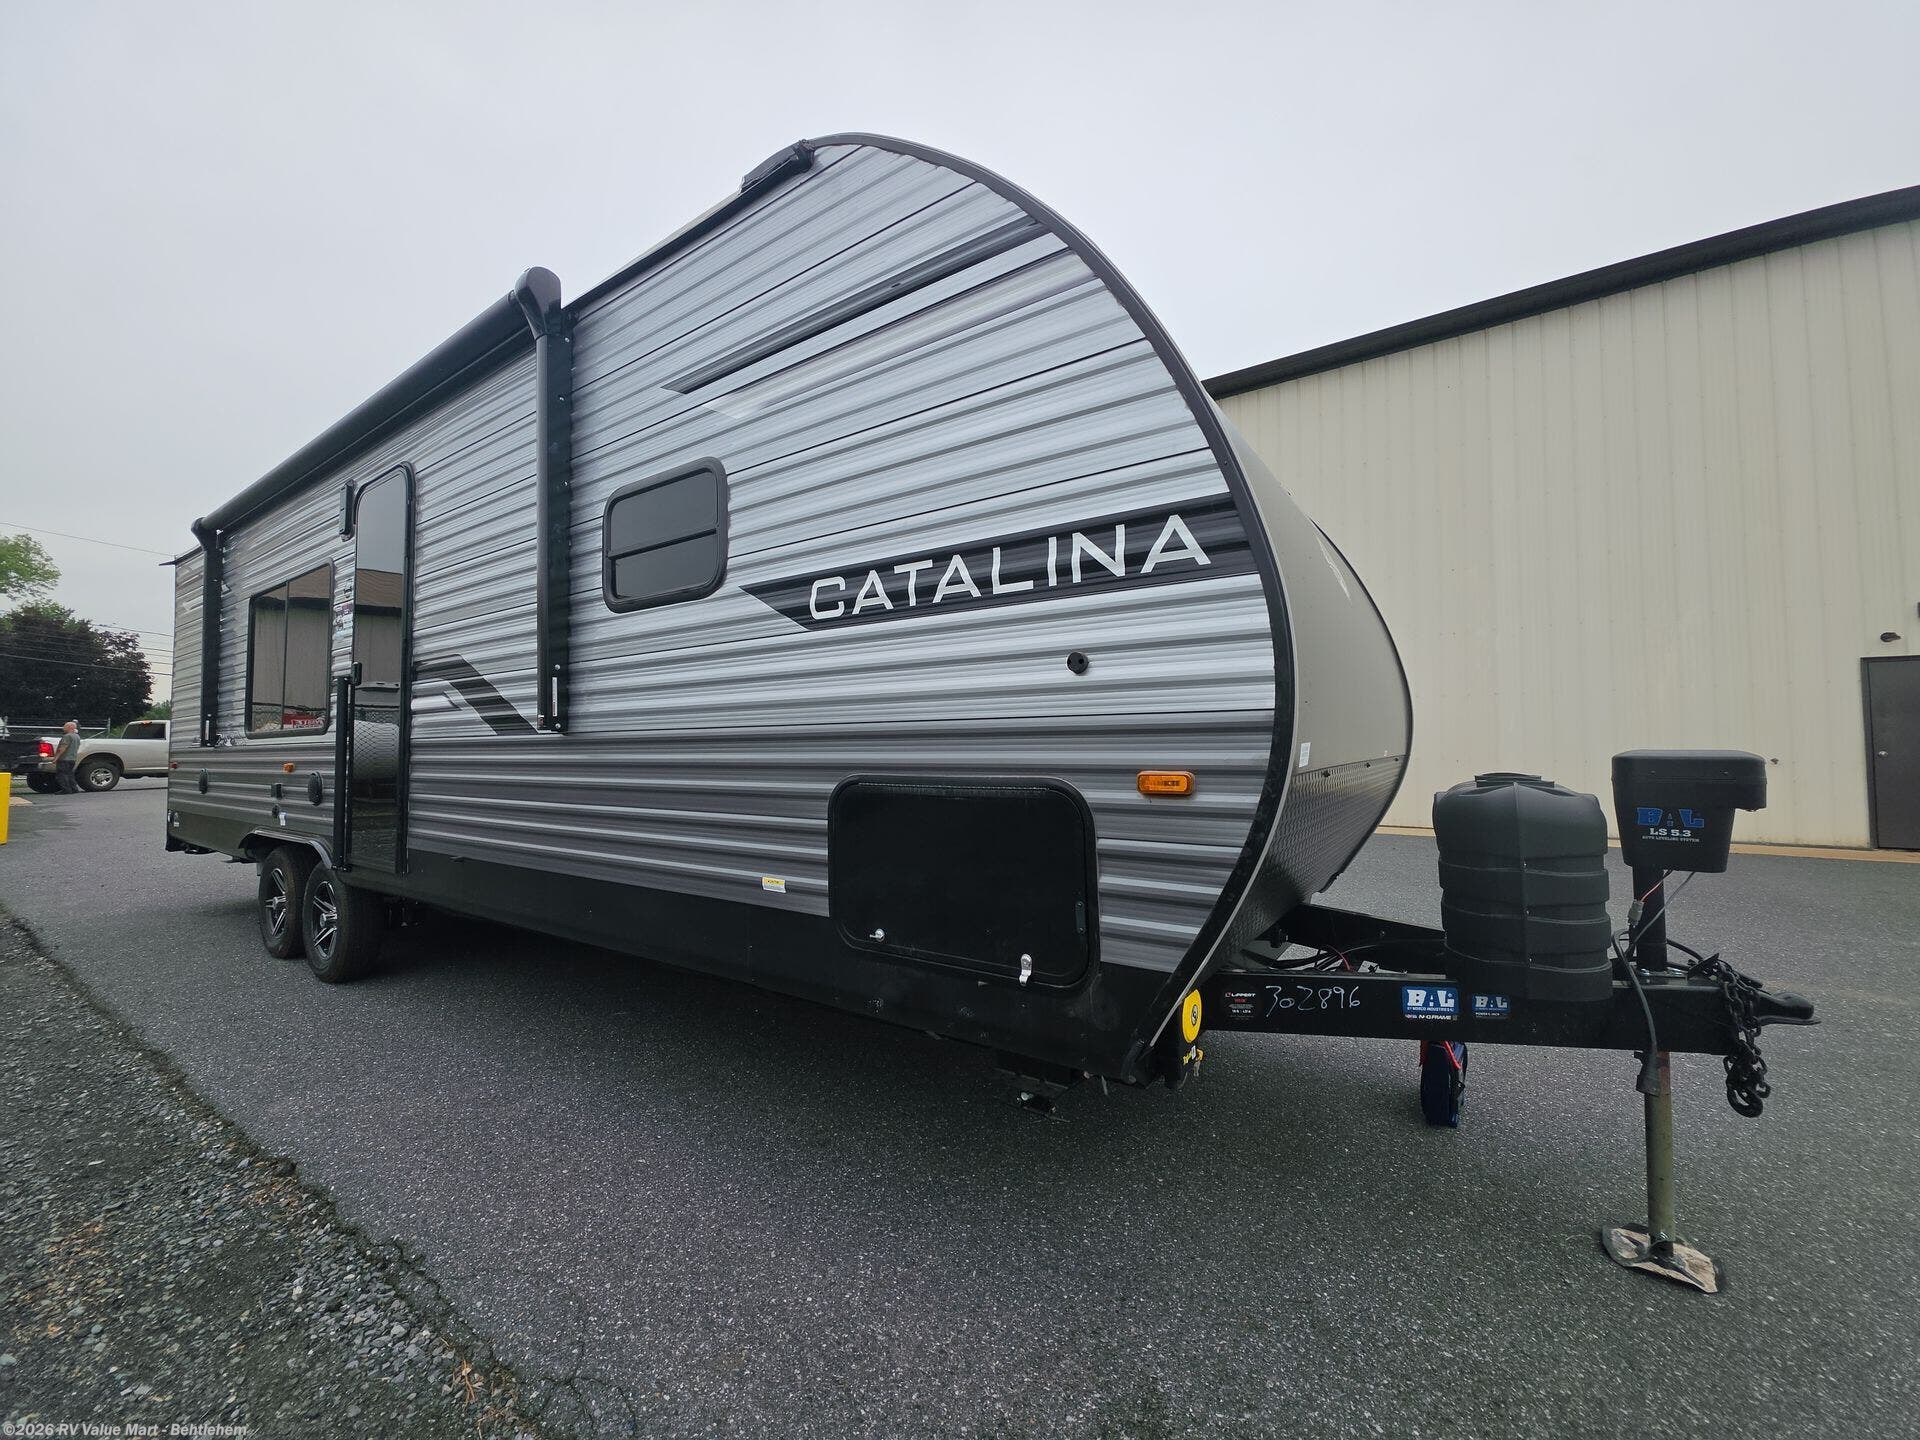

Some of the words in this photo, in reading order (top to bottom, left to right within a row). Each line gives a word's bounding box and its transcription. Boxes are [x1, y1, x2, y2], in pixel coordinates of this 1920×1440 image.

[809, 514, 1211, 621] CATALINA
[1636, 807, 1704, 828] BAL
[1650, 828, 1667, 836] LS
[1265, 985, 1361, 1018] 302896
[1407, 989, 1455, 1008] BAL
